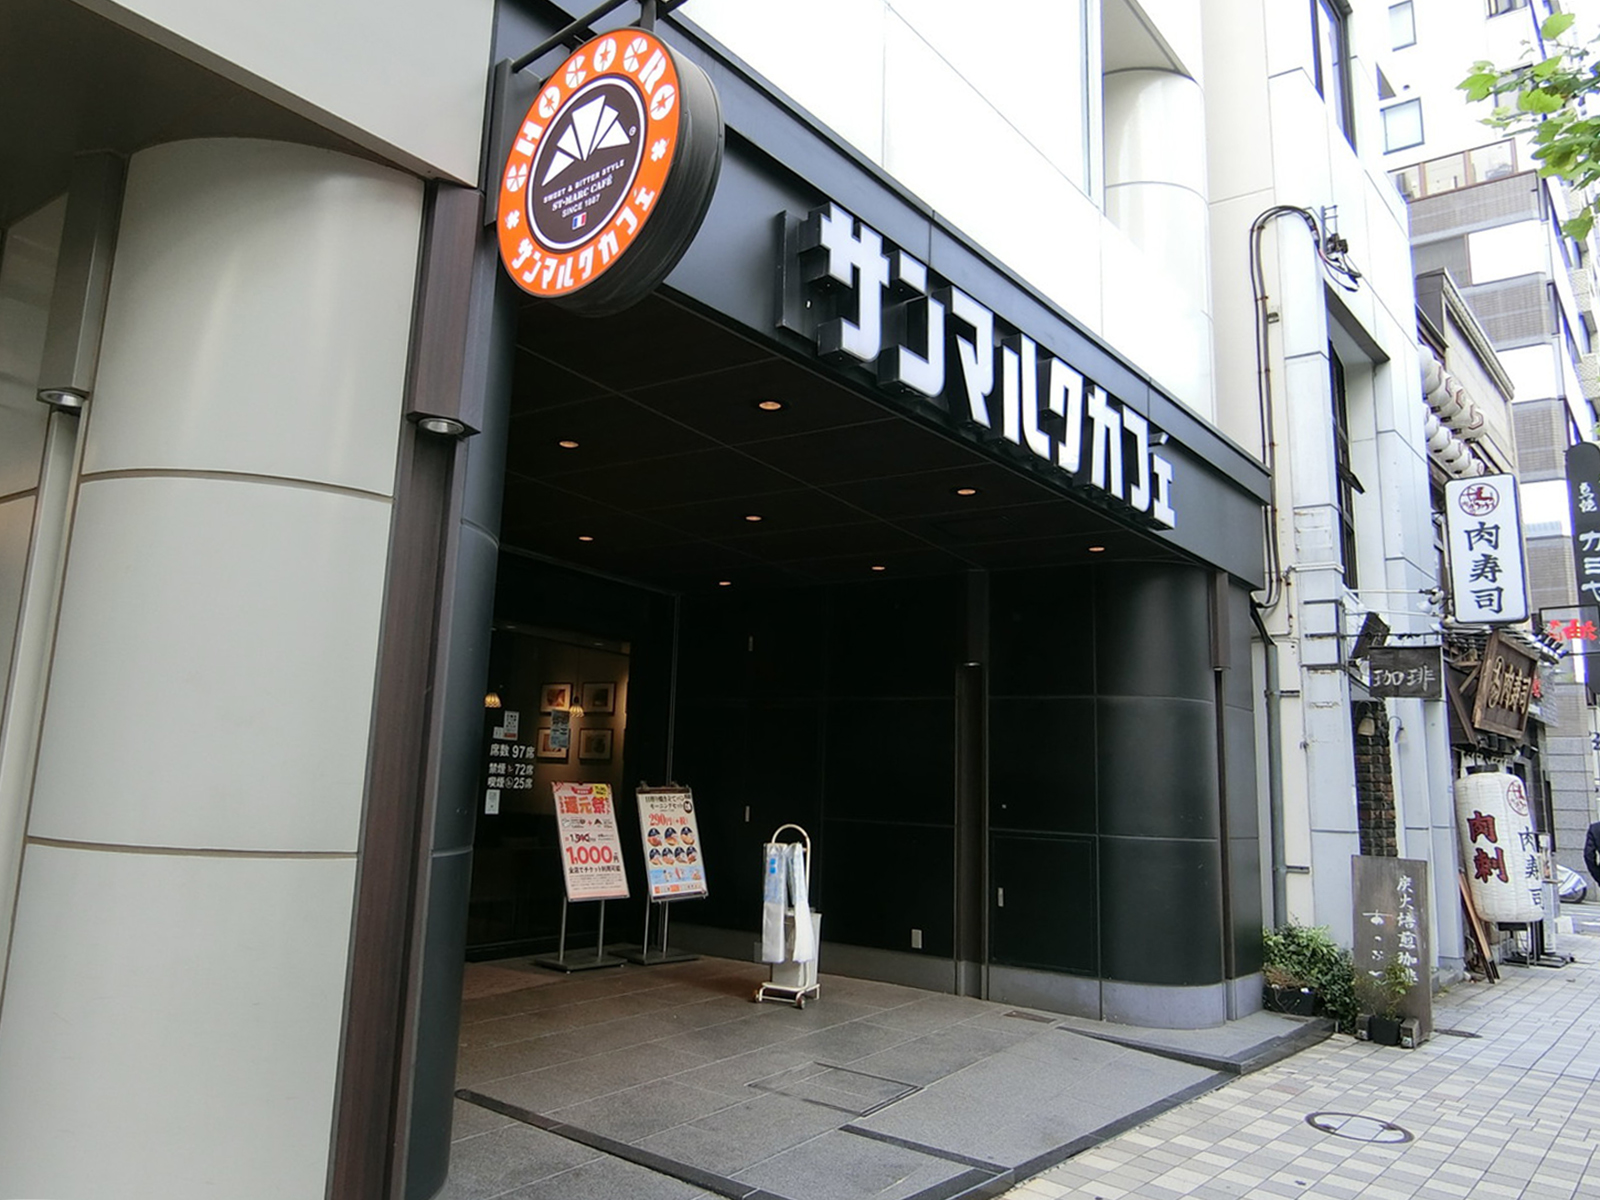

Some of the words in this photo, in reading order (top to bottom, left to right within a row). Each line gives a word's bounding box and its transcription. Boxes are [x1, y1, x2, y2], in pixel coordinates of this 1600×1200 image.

[506, 37, 675, 193] CHOCOCRO
[543, 187, 567, 204] SWEET
[575, 171, 601, 189] BITTER
[601, 158, 625, 176] STYLE
[562, 201, 583, 218] SINCE
[511, 187, 655, 290] サンマルクカフェ
[820, 201, 1176, 529] サンマルクカフェ
[1463, 520, 1504, 614] 肉寿司
[1372, 665, 1436, 691] 珈琲
[1467, 810, 1509, 883] 肉刺
